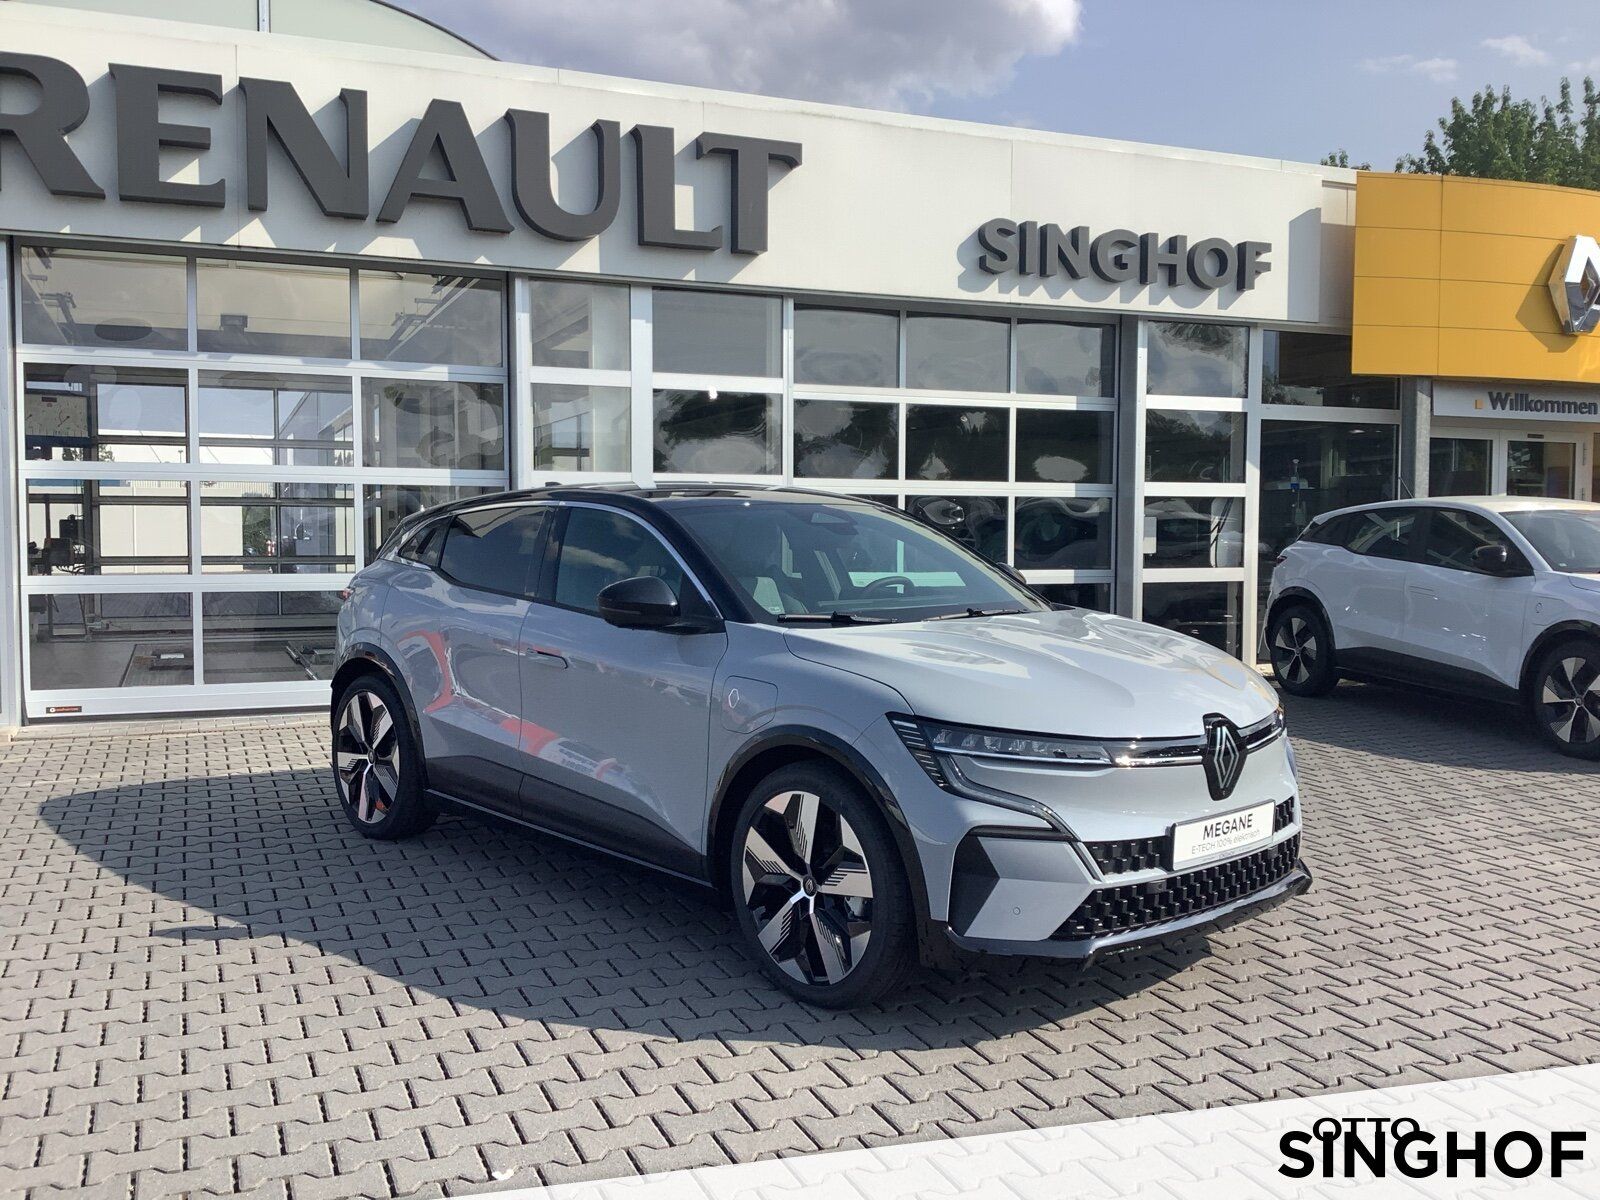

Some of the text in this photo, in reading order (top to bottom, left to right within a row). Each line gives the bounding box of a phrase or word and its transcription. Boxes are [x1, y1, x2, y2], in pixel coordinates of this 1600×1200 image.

[0, 51, 803, 256] RENAULT
[977, 217, 1273, 292] SINGHOF
[1487, 391, 1599, 415] Willkommen
[1203, 813, 1254, 840] MEGANE
[1191, 842, 1216, 855] E-TECH
